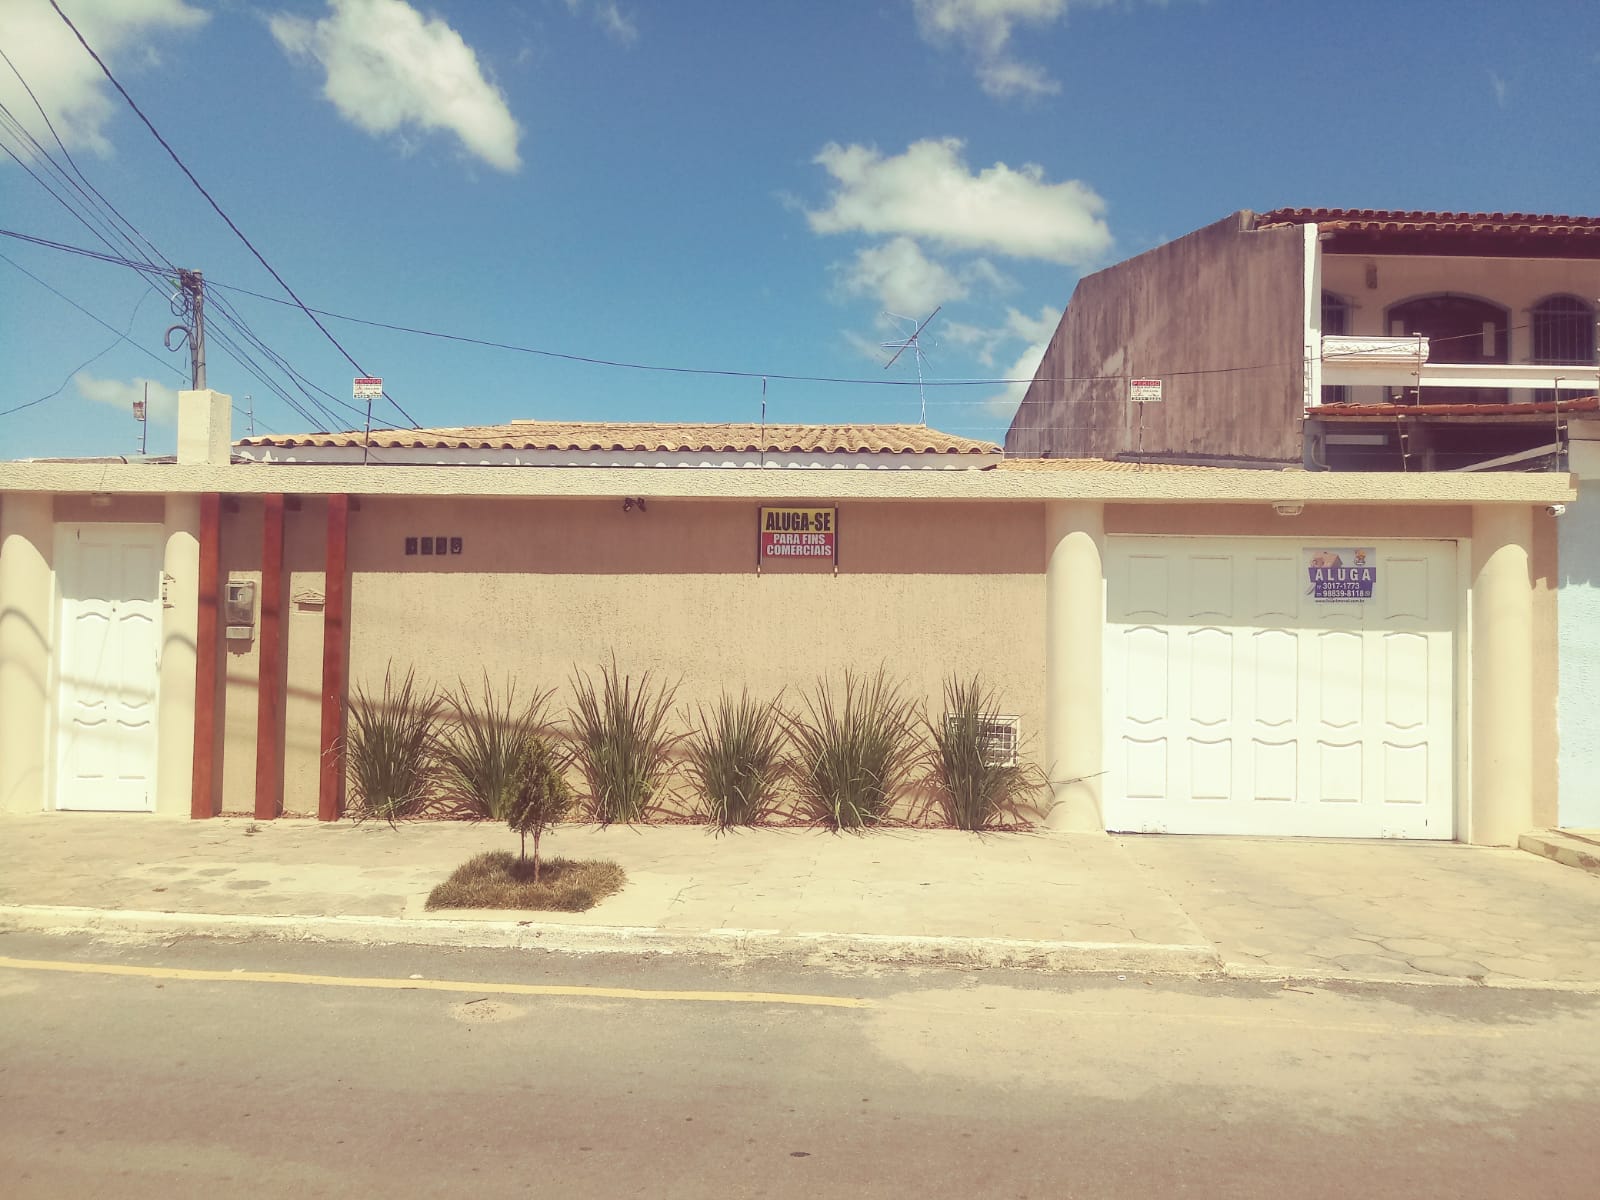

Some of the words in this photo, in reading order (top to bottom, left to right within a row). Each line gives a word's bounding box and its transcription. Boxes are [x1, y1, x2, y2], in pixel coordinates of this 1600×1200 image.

[765, 511, 831, 532] ALUGA-SE
[773, 533, 801, 545] PARA
[802, 533, 826, 545] FINS
[766, 544, 832, 556] COMERCIAIS
[1315, 568, 1372, 581] ALUGA
[1322, 582, 1360, 590] 3017-1773
